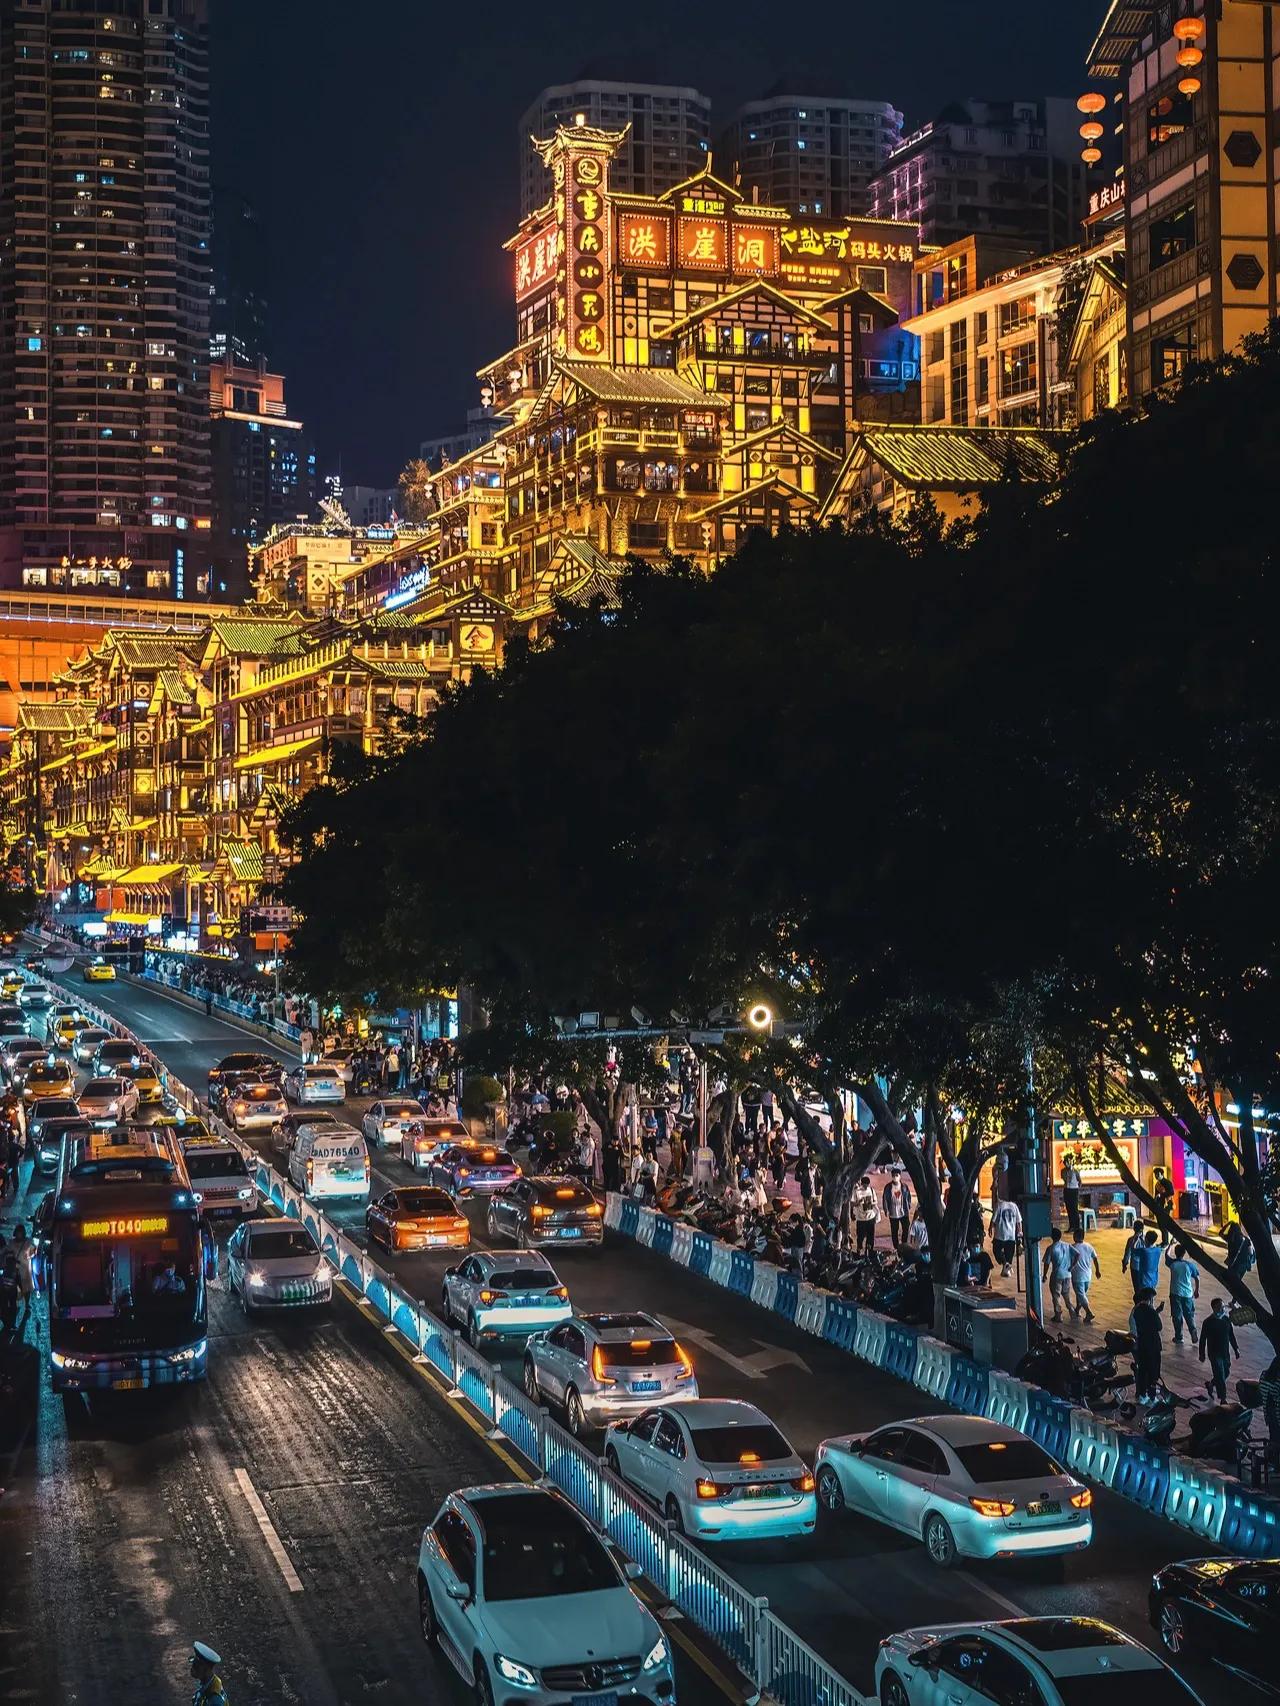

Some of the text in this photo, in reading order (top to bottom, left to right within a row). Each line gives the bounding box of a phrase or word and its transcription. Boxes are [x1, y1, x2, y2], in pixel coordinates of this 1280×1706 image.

[629, 225, 765, 268] 洪崖洞
[850, 241, 914, 262] 码头火锅
